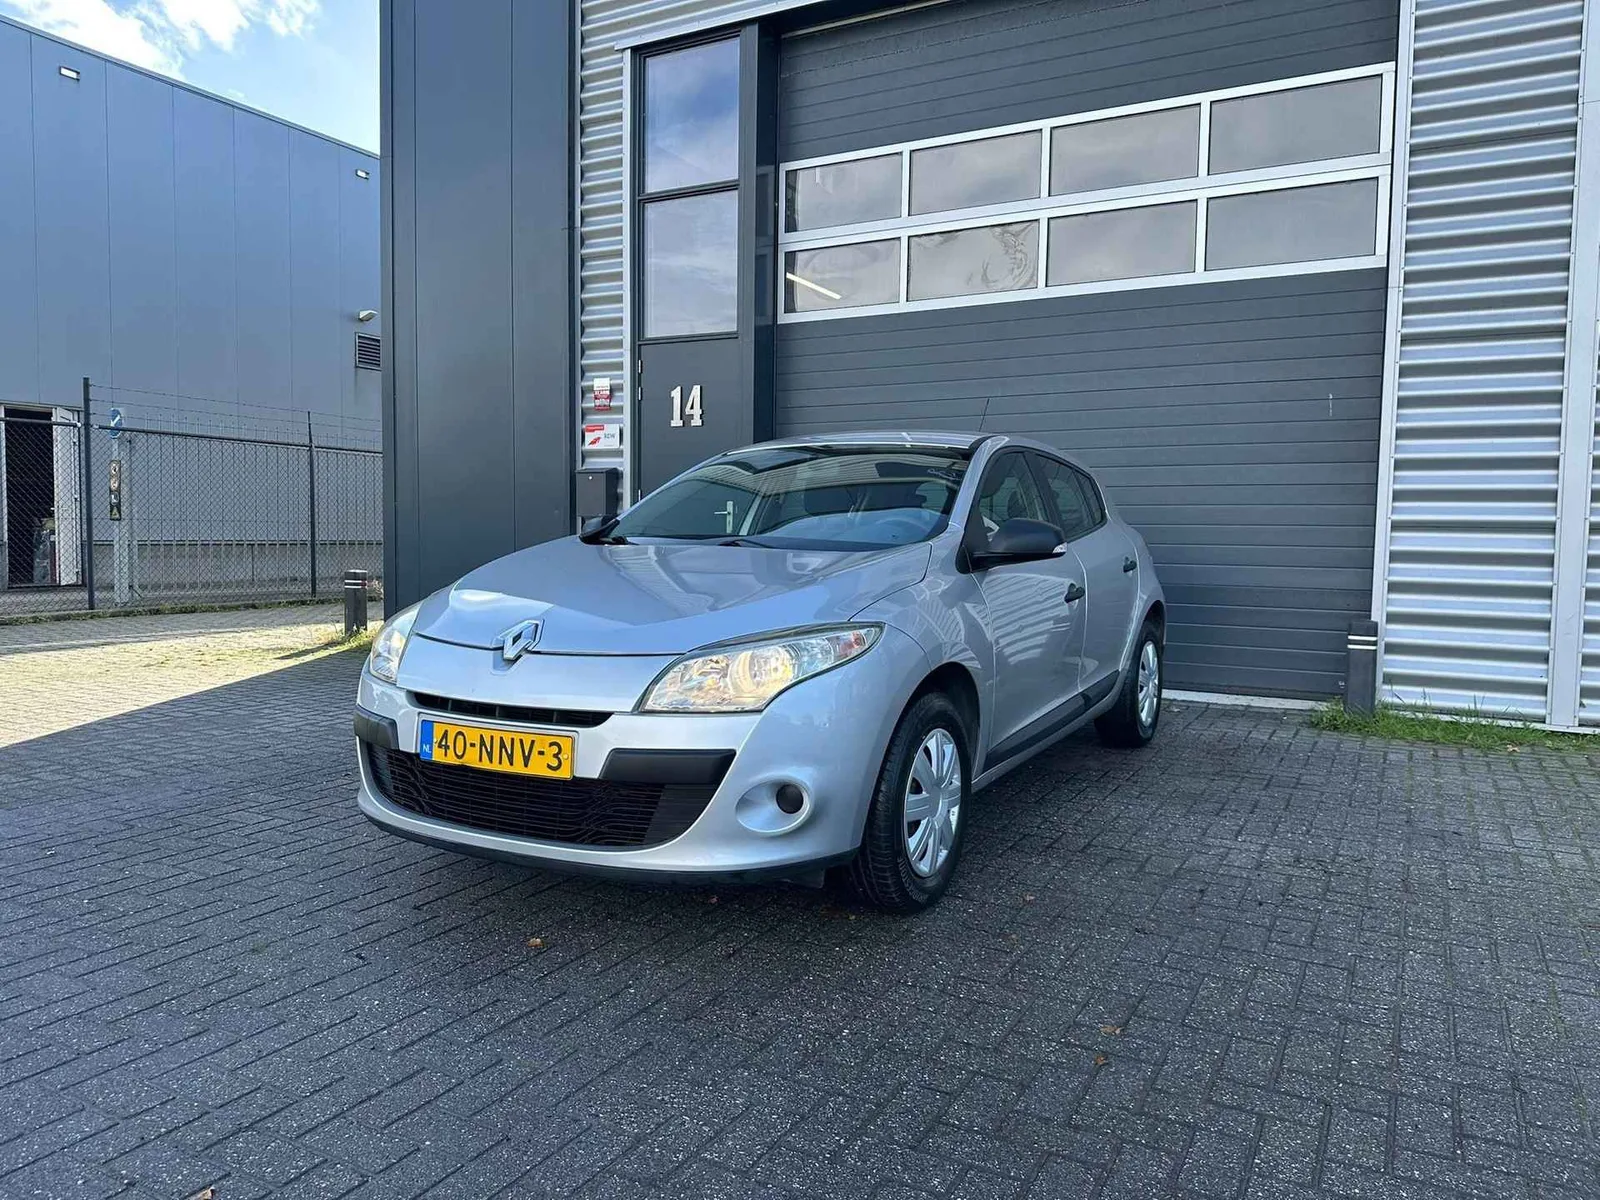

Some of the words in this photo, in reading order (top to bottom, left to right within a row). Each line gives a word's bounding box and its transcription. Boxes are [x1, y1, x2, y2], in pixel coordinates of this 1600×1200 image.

[670, 384, 703, 427] 14
[422, 743, 432, 753] NL
[437, 729, 563, 772] 40-NNV-3
